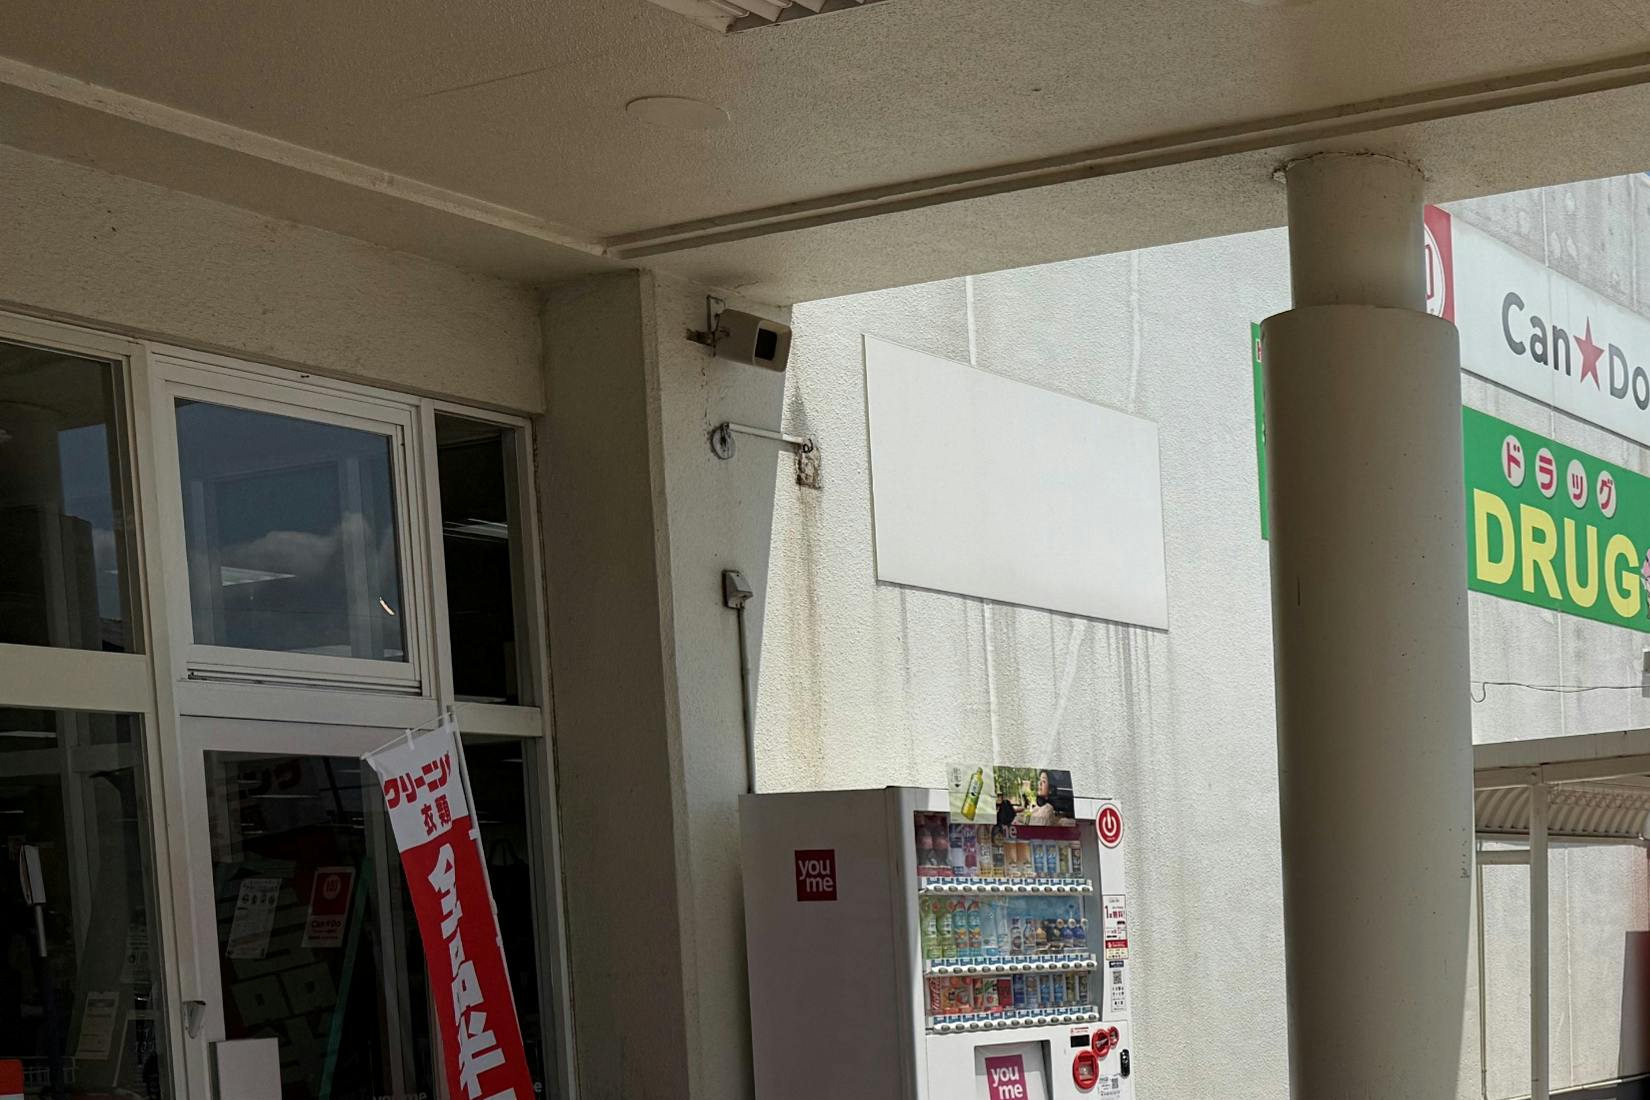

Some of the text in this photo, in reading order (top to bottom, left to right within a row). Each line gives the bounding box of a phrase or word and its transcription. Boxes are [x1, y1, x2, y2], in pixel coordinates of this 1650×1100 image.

[1502, 291, 1650, 411] Can Do
[1503, 437, 1616, 516] ドラッグ
[1473, 487, 1641, 618] DRUG
[384, 750, 451, 809] クリーニン
[421, 794, 452, 837] 衣類
[798, 858, 831, 885] you
[806, 874, 833, 893] me
[990, 1064, 1021, 1094] you
[998, 1081, 1024, 1100] me
